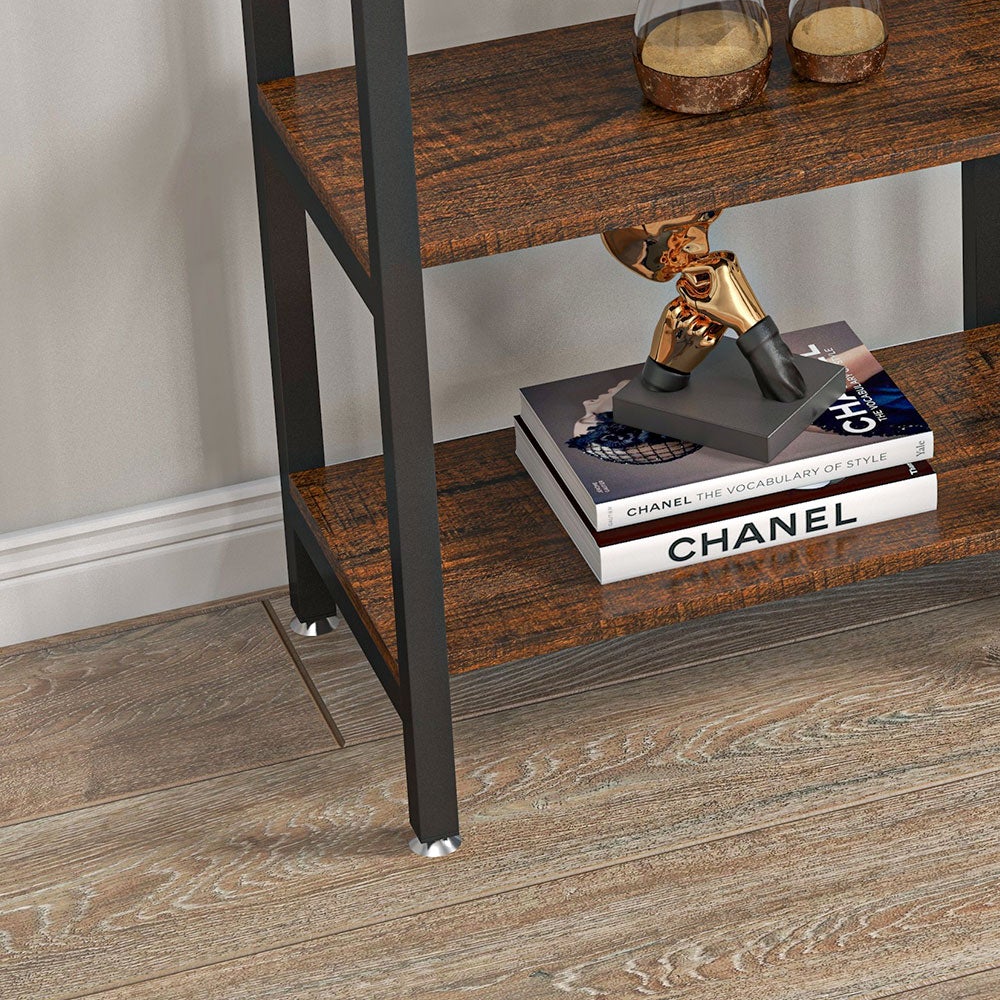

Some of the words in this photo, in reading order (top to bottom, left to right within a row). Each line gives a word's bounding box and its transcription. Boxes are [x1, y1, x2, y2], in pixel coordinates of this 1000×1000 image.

[916, 439, 926, 457] Yale
[627, 496, 692, 517] CHANEL
[696, 488, 722, 501] THE
[726, 466, 821, 494] VOCABULARY
[824, 462, 844, 474] OF
[847, 452, 887, 469] STYLE
[668, 502, 857, 562] CHANEL
